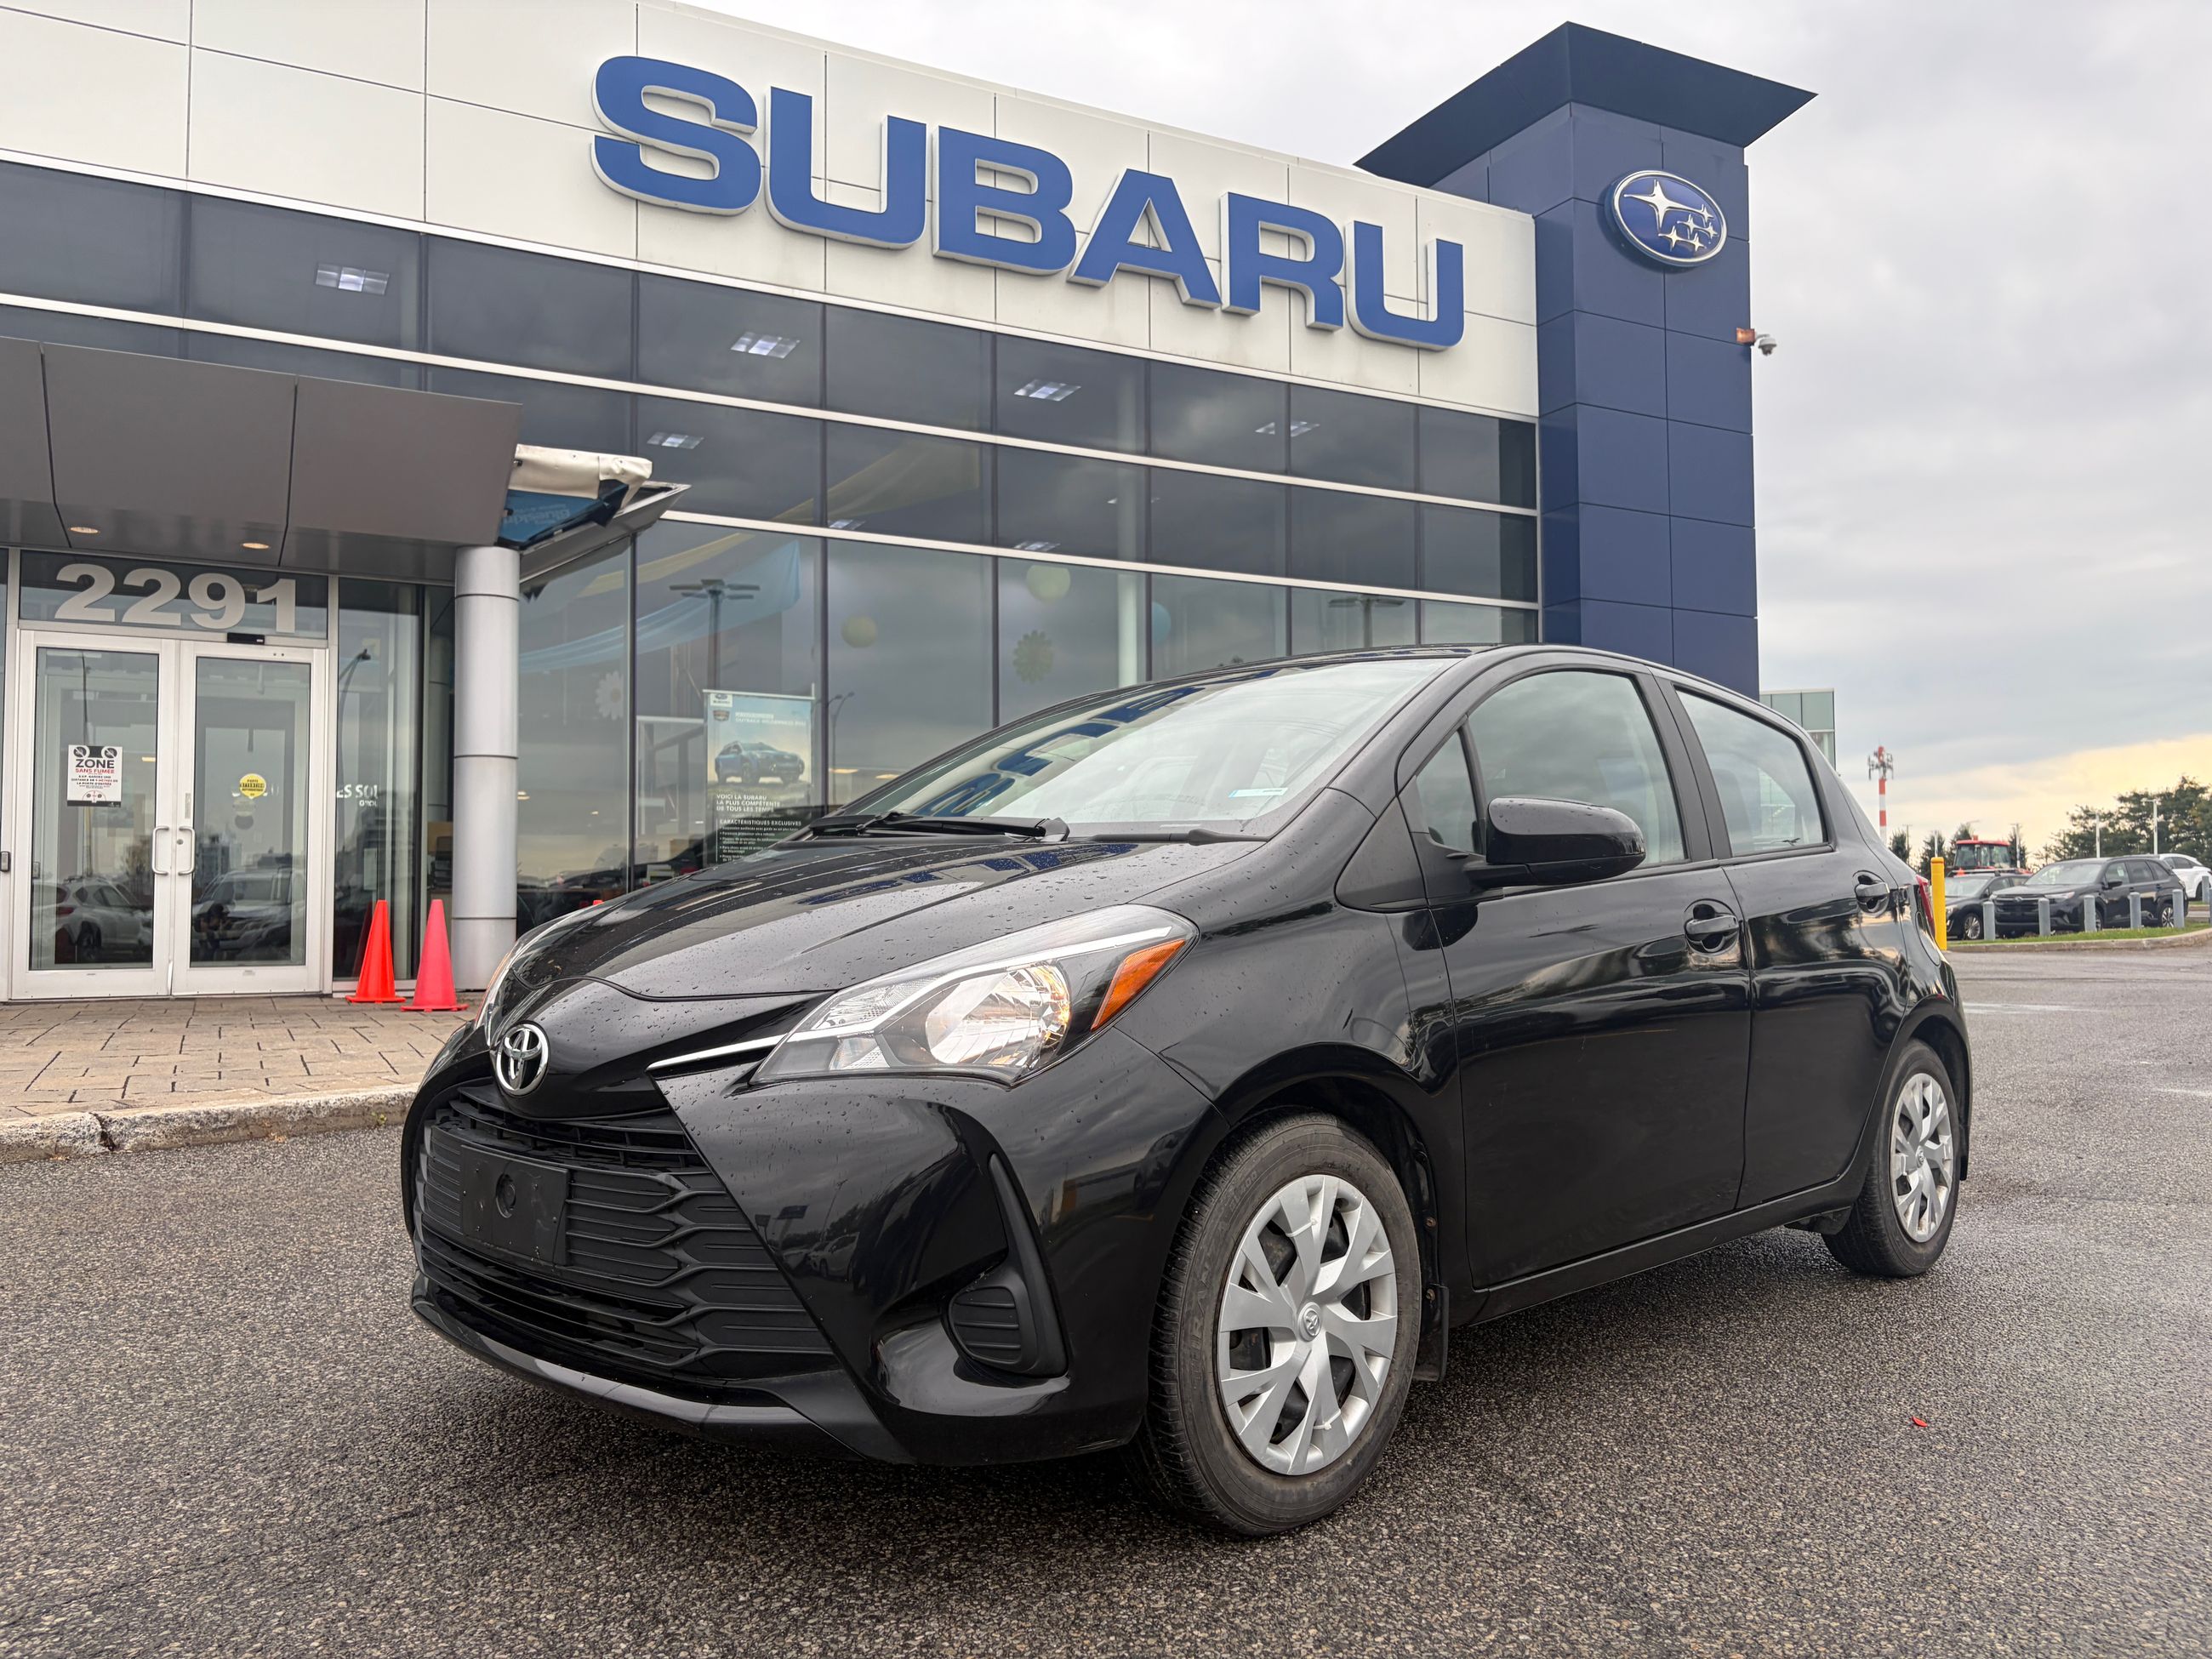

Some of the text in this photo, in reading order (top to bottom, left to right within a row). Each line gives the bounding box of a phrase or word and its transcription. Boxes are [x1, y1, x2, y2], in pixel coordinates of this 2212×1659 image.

[591, 55, 1464, 350] SUBARU
[54, 562, 297, 634] 2291
[75, 759, 115, 769] ZONE
